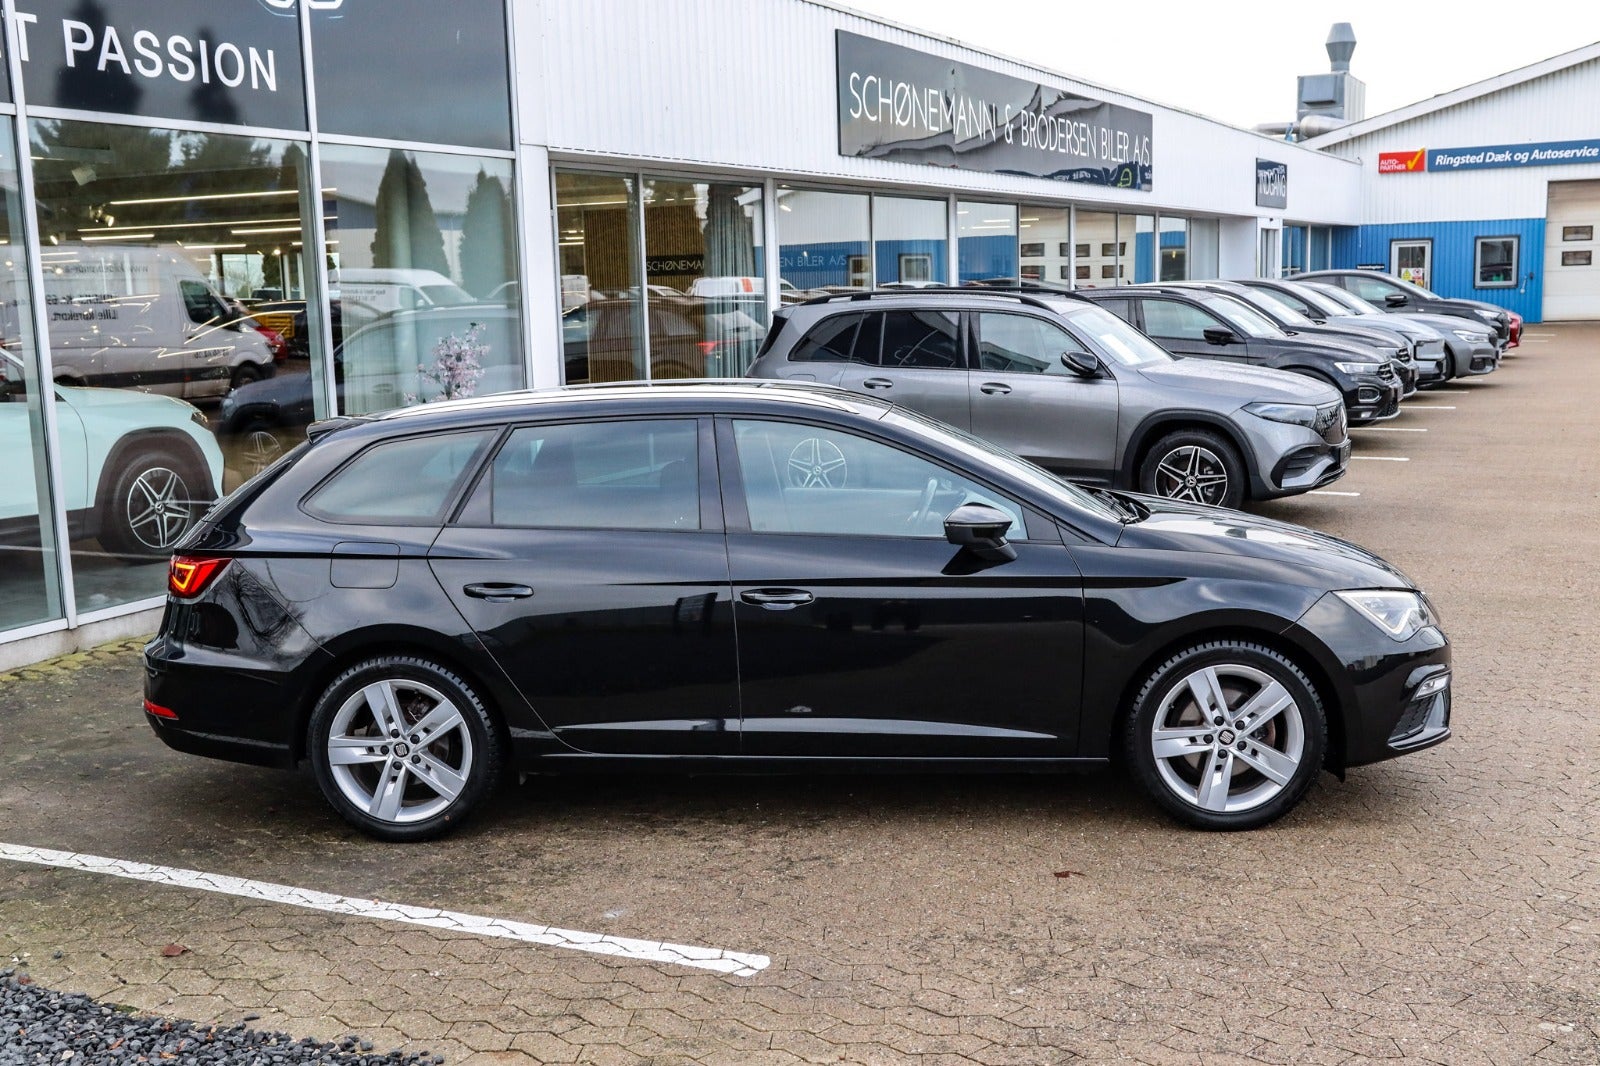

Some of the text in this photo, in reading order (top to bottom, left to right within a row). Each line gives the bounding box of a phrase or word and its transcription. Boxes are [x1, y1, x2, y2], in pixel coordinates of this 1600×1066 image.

[62, 19, 277, 91] PASSION
[849, 71, 1150, 167] SCHØNEMANN & BRODERSEN BILER A/S
[1435, 145, 1600, 167] Ringsted Dæk og Autoservice
[1258, 170, 1286, 198] INDGANG
[797, 255, 824, 267] BILER
[829, 253, 847, 266] A/S
